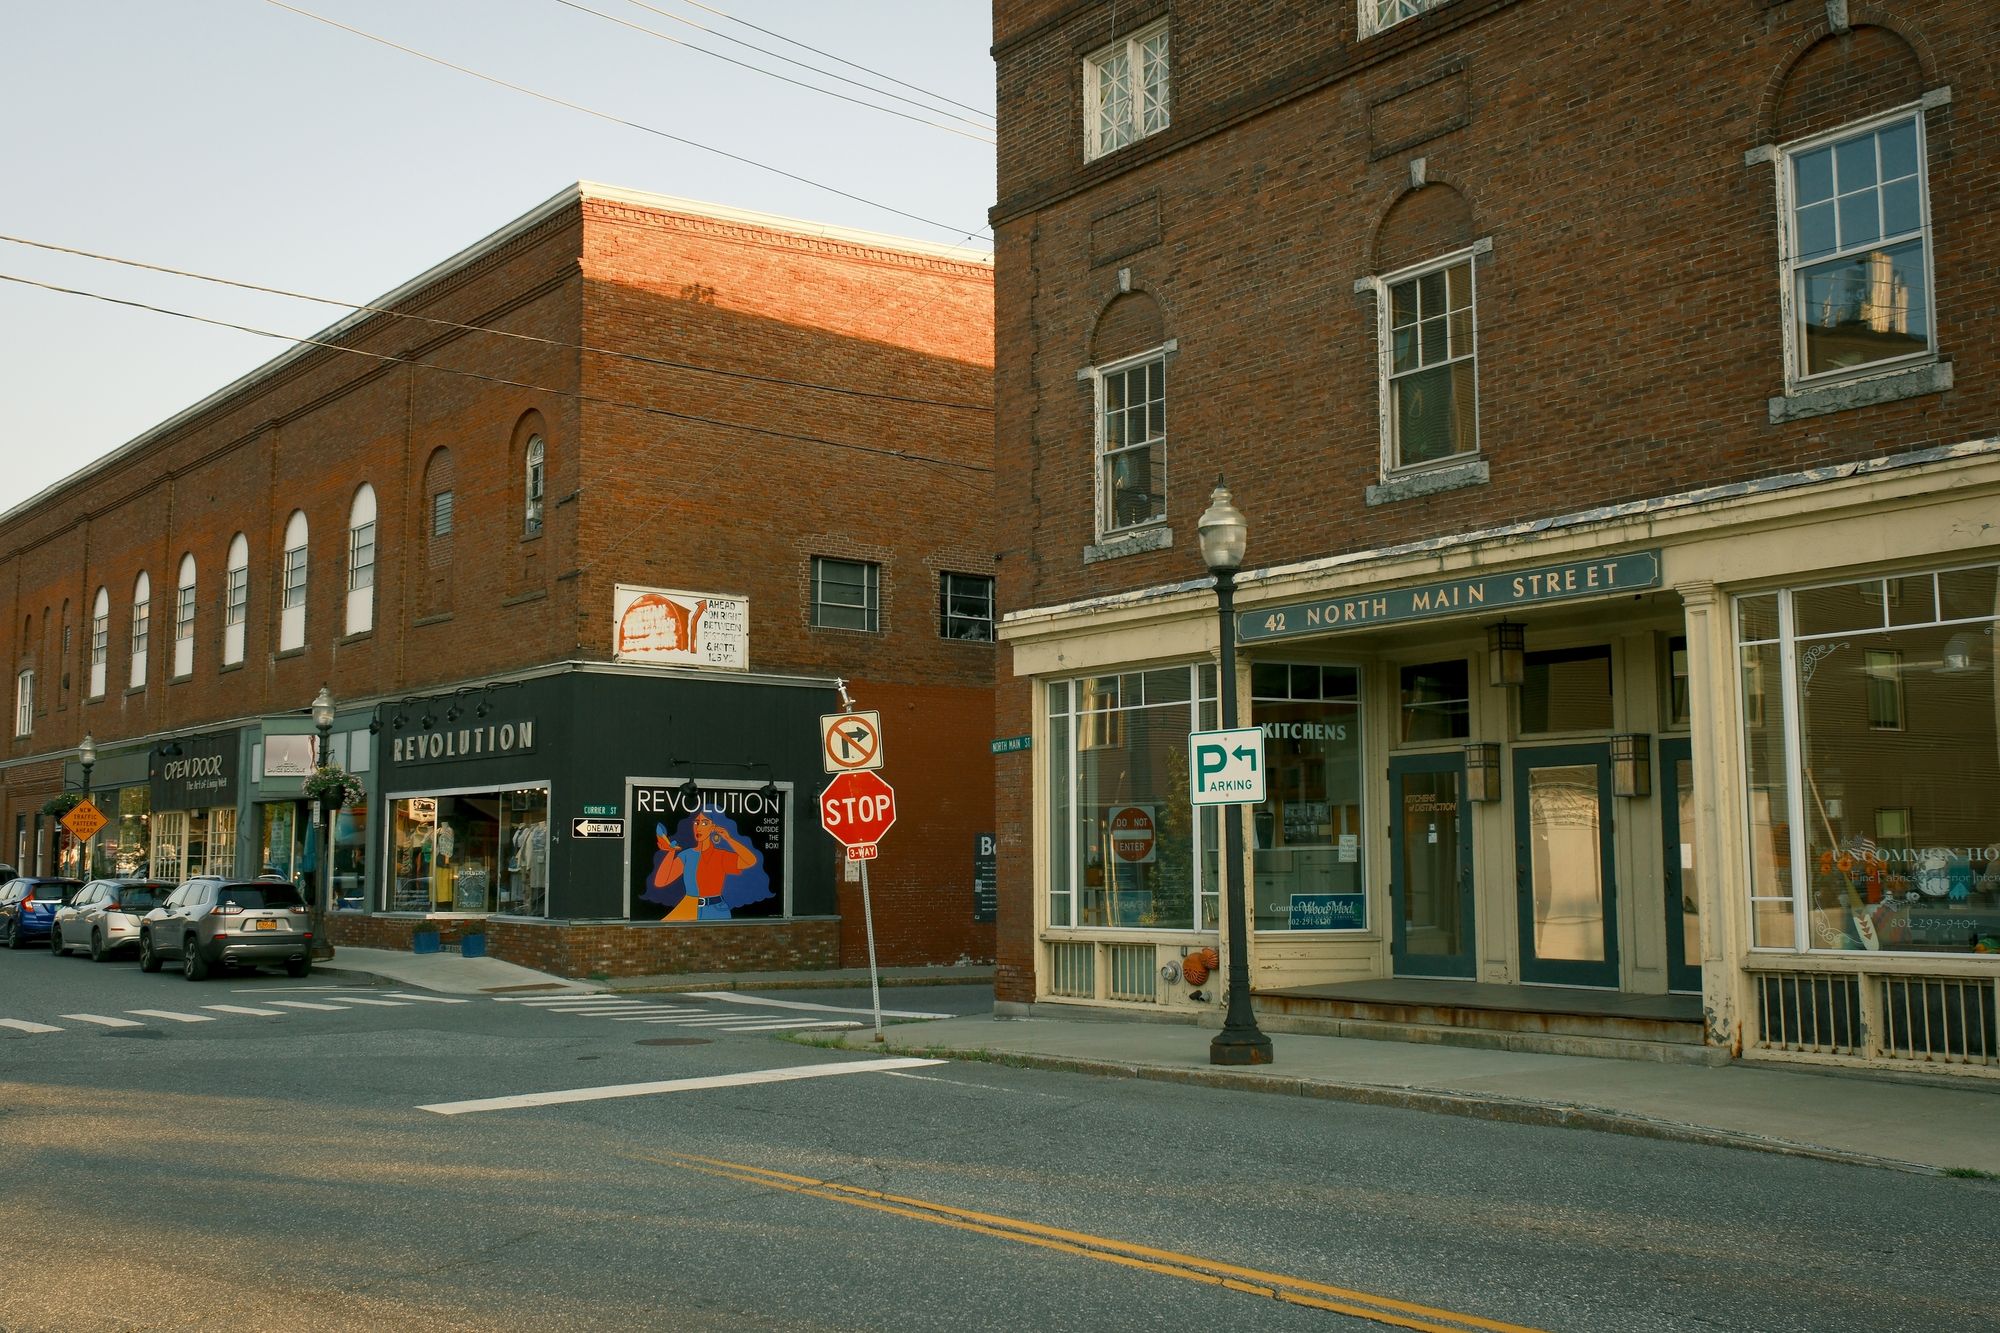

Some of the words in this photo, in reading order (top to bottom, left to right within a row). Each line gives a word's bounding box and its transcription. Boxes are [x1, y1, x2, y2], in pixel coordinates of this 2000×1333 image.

[1264, 612, 1285, 631] 42
[1307, 597, 1386, 626] NORTH
[1413, 583, 1483, 612] MAIN
[1512, 563, 1618, 598] STREET
[1262, 722, 1347, 740] KITCHENS
[394, 722, 533, 761] REVOLUTION
[992, 741, 1008, 753] NORTH
[1009, 739, 1021, 750] MAIN
[165, 759, 191, 780] OPEN
[191, 755, 222, 778] DOOR
[638, 790, 780, 814] REVOLUTION
[584, 806, 606, 815] CURRIER
[610, 806, 618, 815] ST
[826, 794, 891, 826] STOP
[586, 824, 601, 832] ONE
[603, 824, 620, 832] WAY
[763, 818, 780, 826] SHOP
[1116, 818, 1128, 828] DO
[1134, 818, 1150, 828] NOT
[849, 846, 876, 858] 3-WAY
[1119, 841, 1145, 851] ENTER
[1831, 847, 1960, 862] UNCOMMON
[1966, 847, 2000, 862] HO
[1972, 868, 2000, 885] Inter
[1890, 918, 1980, 930] 802-295-9404
